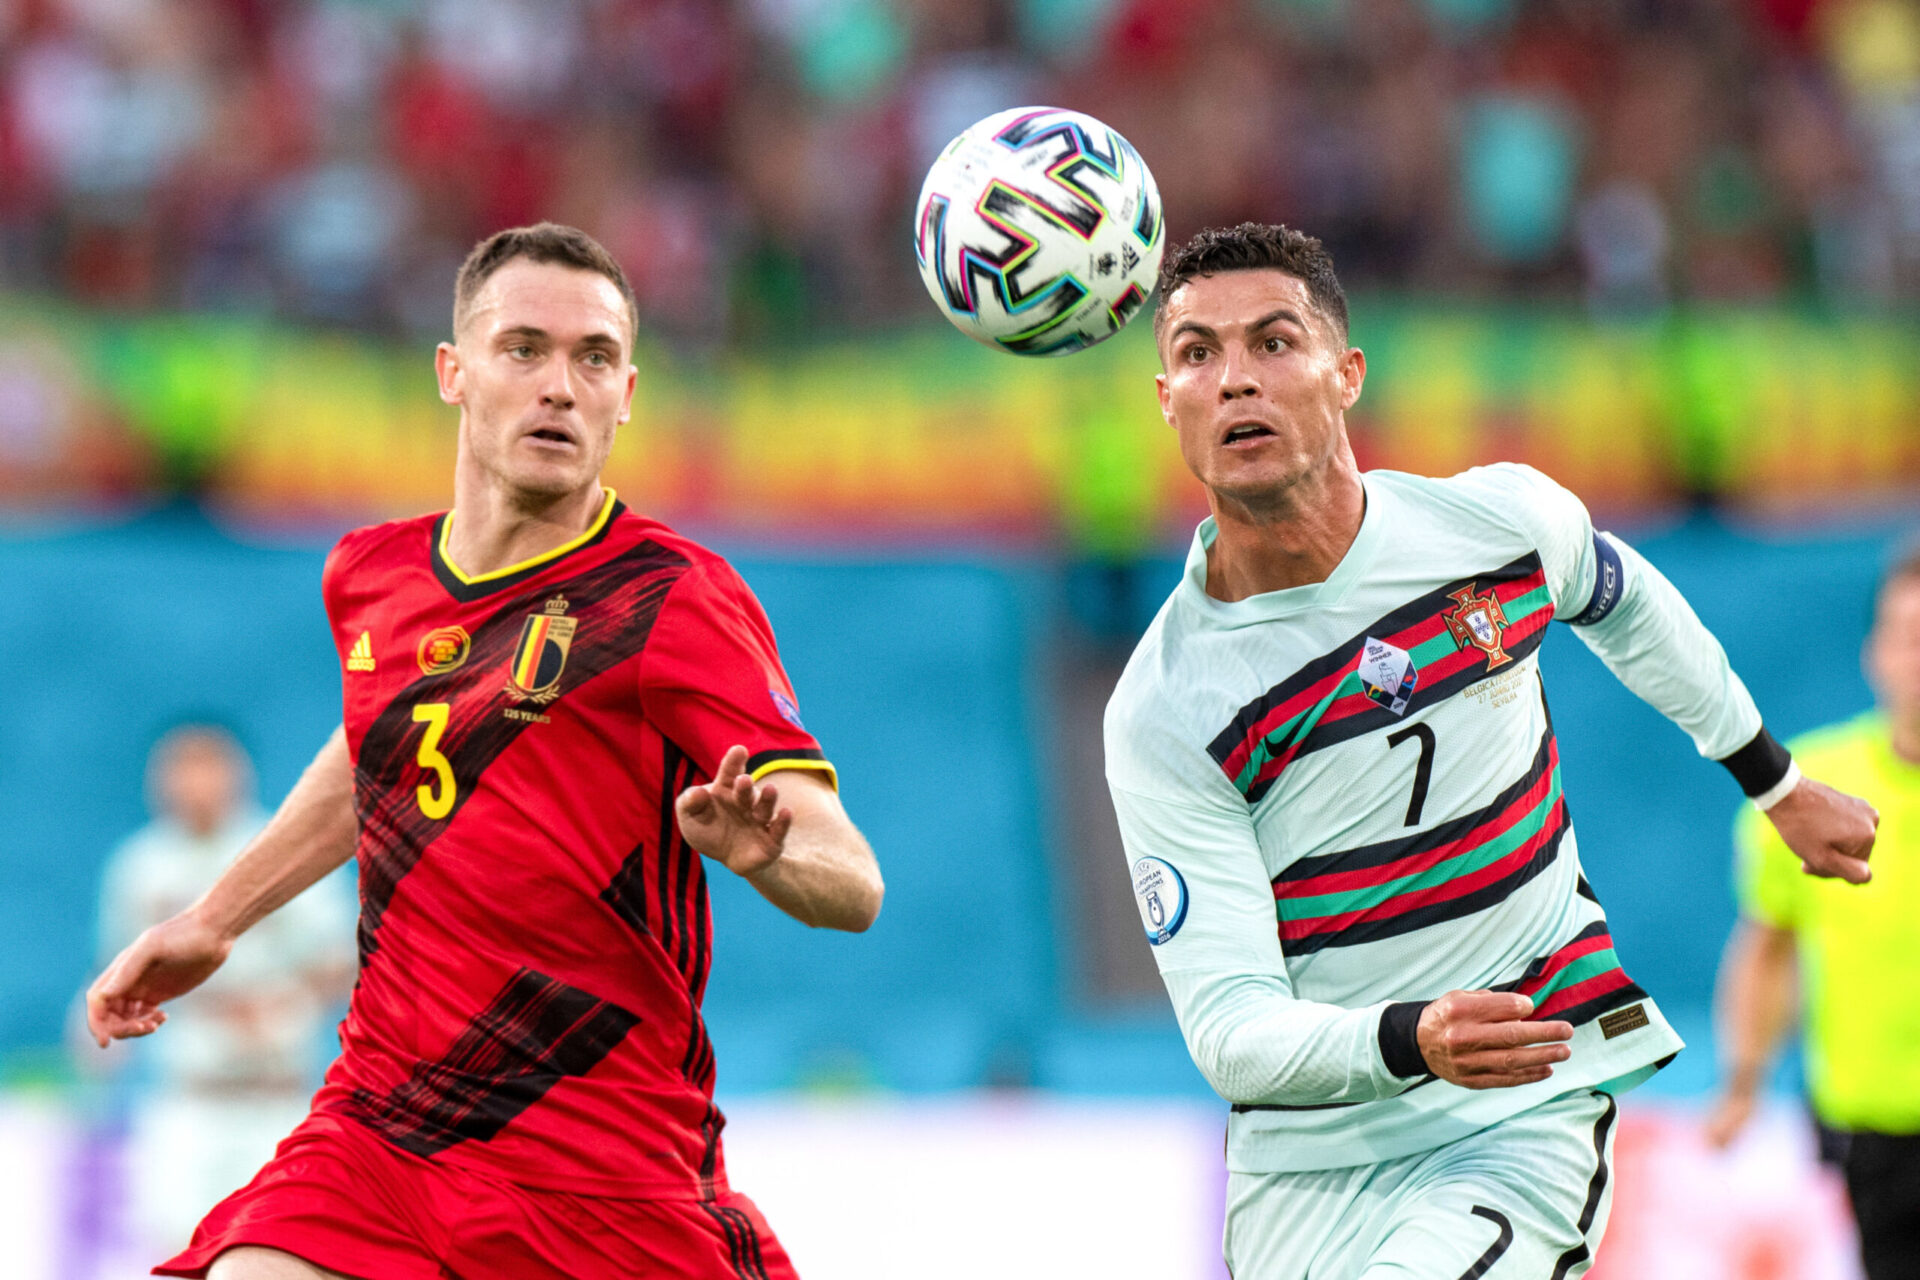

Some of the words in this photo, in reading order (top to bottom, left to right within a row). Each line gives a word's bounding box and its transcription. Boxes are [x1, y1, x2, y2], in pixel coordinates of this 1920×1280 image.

[1586, 560, 1616, 620] SPECT
[521, 711, 551, 724] YEARS
[412, 703, 458, 820] 3
[1387, 722, 1436, 827] 7
[1456, 1205, 1514, 1280] 7
